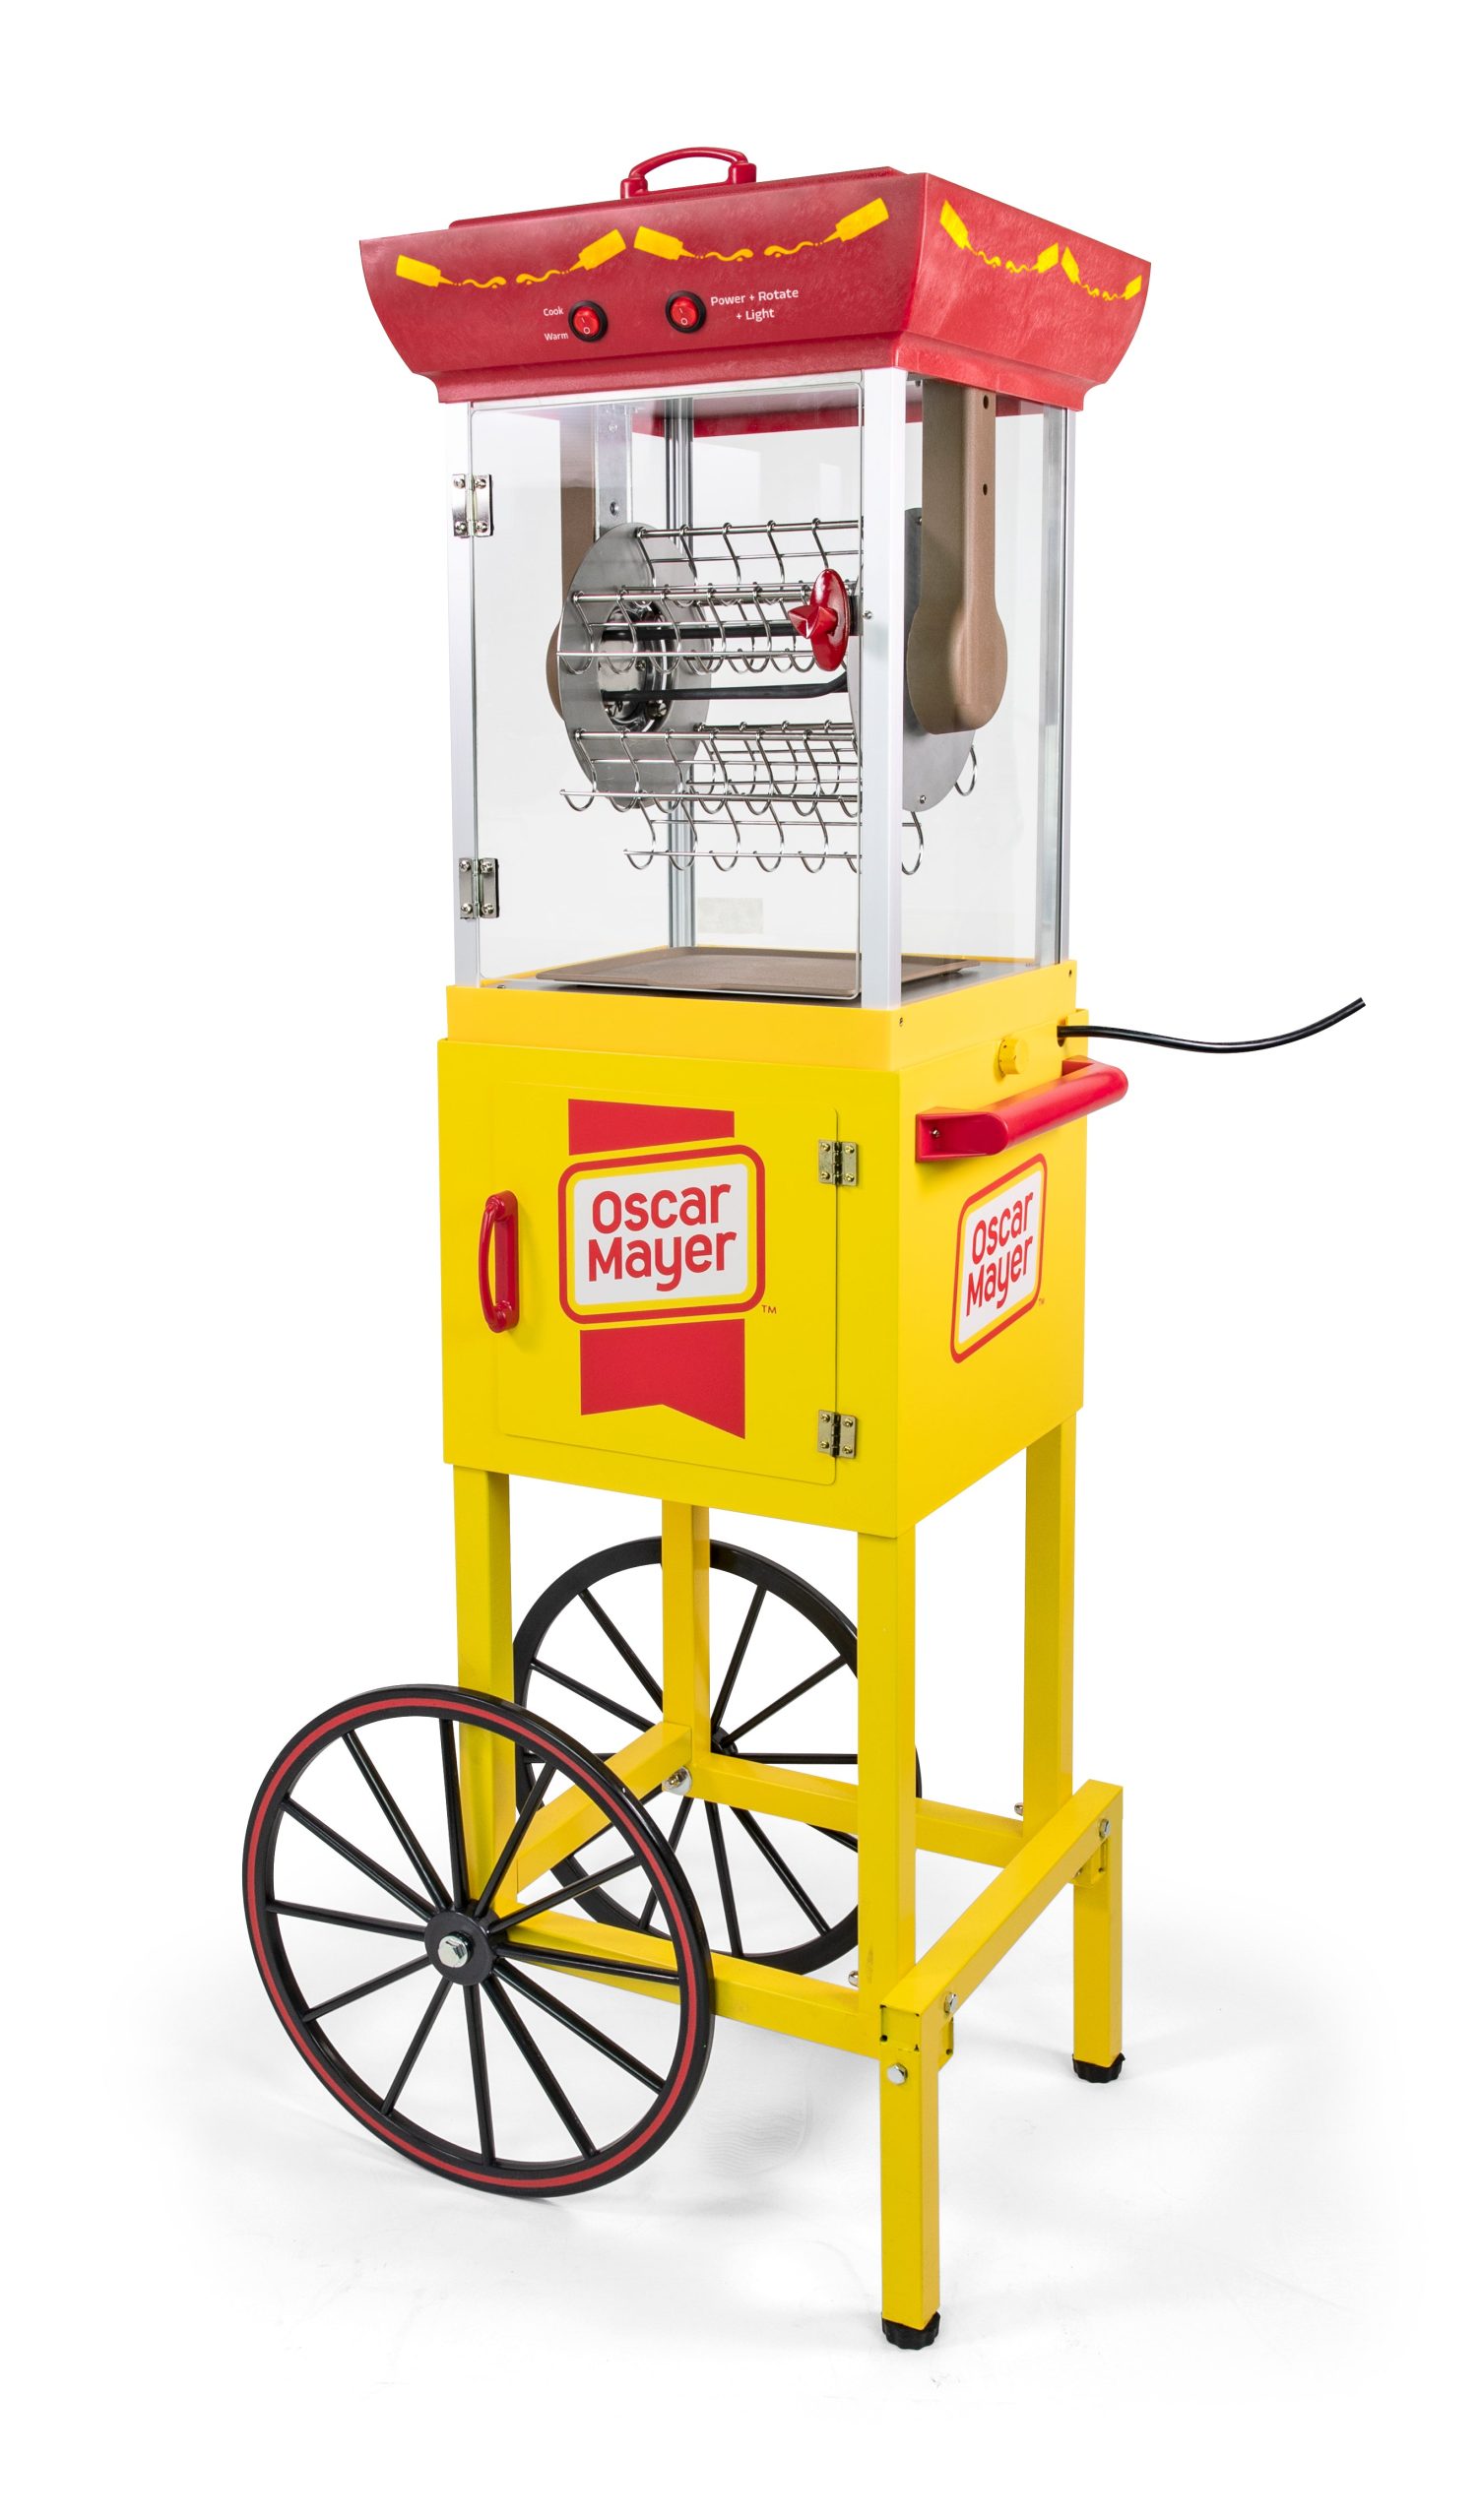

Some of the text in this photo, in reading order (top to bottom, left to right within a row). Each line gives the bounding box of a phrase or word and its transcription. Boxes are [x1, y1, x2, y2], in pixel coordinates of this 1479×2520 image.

[543, 306, 564, 316] Cook
[710, 295, 745, 306] Power
[757, 288, 799, 301] Rotate
[745, 307, 775, 323] Light
[544, 332, 569, 341] Warm
[592, 1183, 732, 1234] Oscar
[971, 1192, 1034, 1265] Oscar
[588, 1230, 738, 1292] Mayer
[965, 1235, 1034, 1317] Mayer
